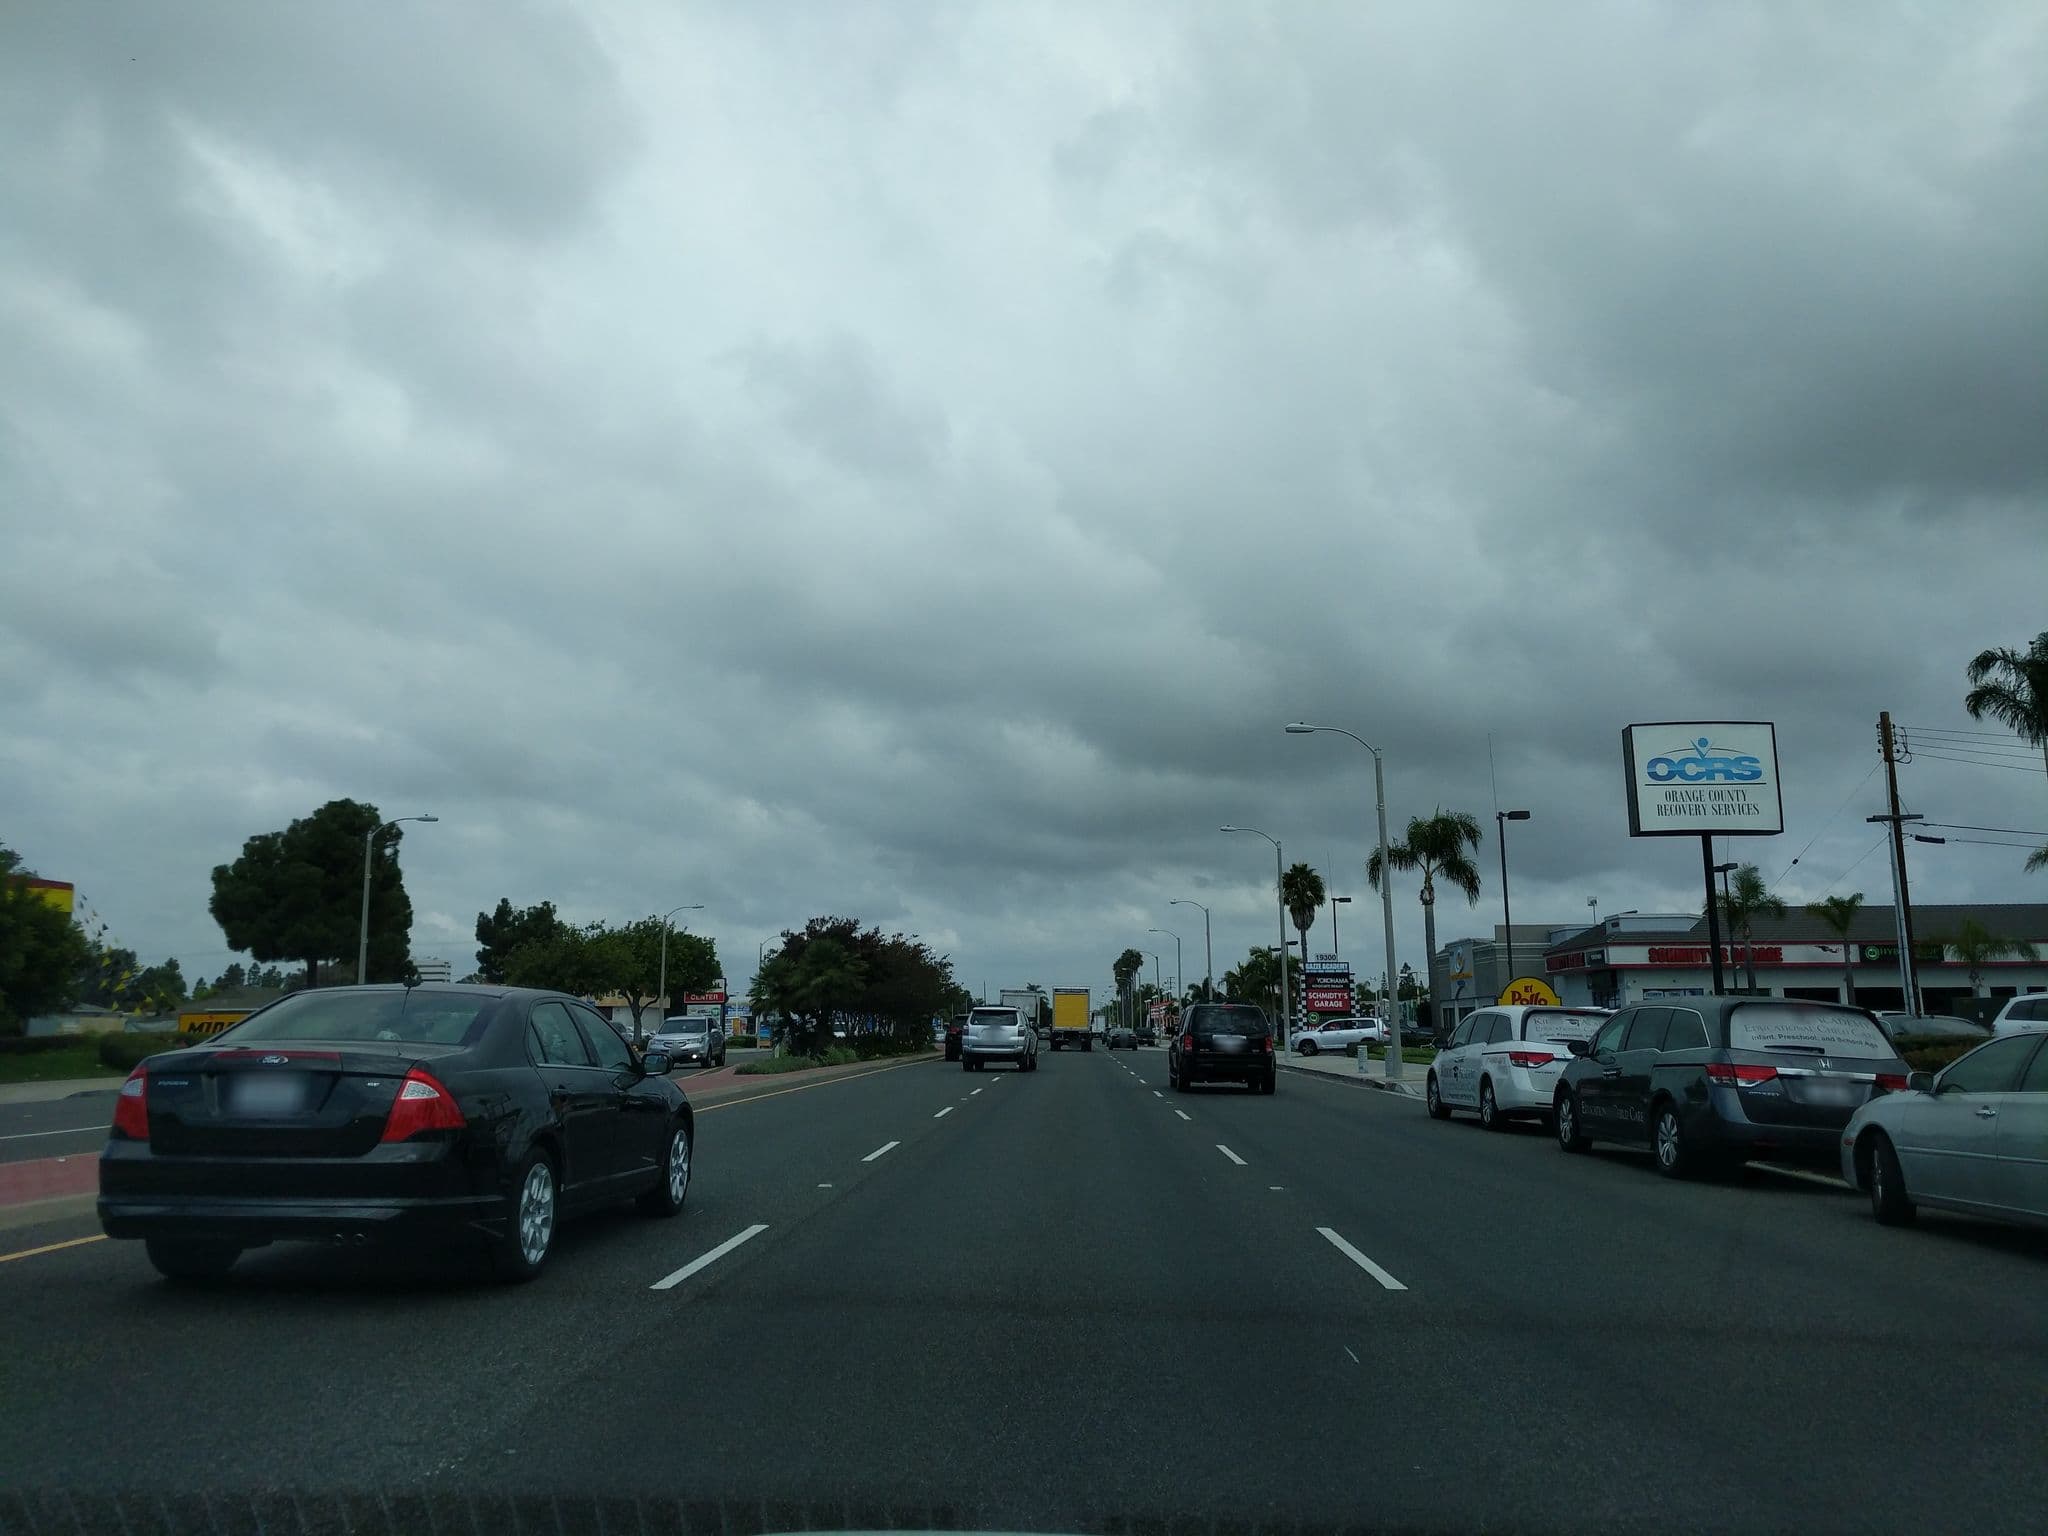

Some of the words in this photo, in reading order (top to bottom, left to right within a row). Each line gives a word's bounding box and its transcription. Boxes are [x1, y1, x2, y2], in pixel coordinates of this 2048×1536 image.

[1647, 756, 1762, 781] OCRS
[1665, 790, 1705, 802] ORANGE
[1708, 789, 1747, 802] COUNTY
[1657, 804, 1707, 817] RECOVERY
[1712, 803, 1760, 816] SERVICES
[1524, 985, 1533, 993] El
[690, 993, 719, 1001] CENTER
[1511, 990, 1548, 1005] Pollo
